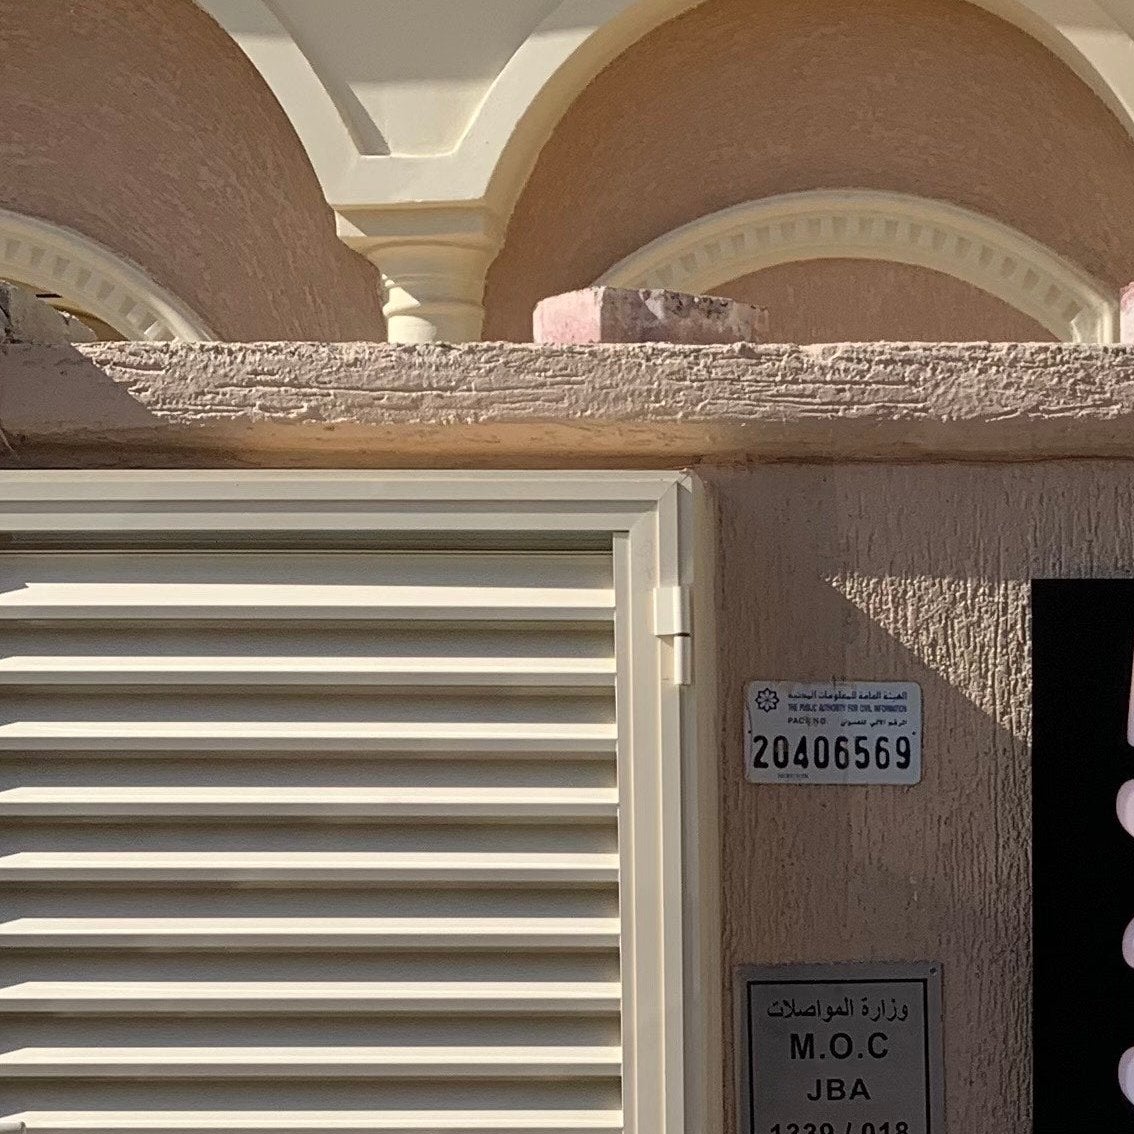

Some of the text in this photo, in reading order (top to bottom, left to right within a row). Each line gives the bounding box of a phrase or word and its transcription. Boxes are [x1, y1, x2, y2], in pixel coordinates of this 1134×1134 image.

[800, 703, 817, 712] PUBLIC
[819, 703, 846, 712] AUTHORITY
[848, 703, 859, 712] FOR
[860, 703, 873, 712] CIVIL
[874, 703, 907, 713] INFORMATION
[752, 735, 911, 770] 20406569
[766, 996, 909, 1022] وزارة المواصلات
[790, 1032, 889, 1060] M.O.C
[806, 1078, 872, 1101] JBA
